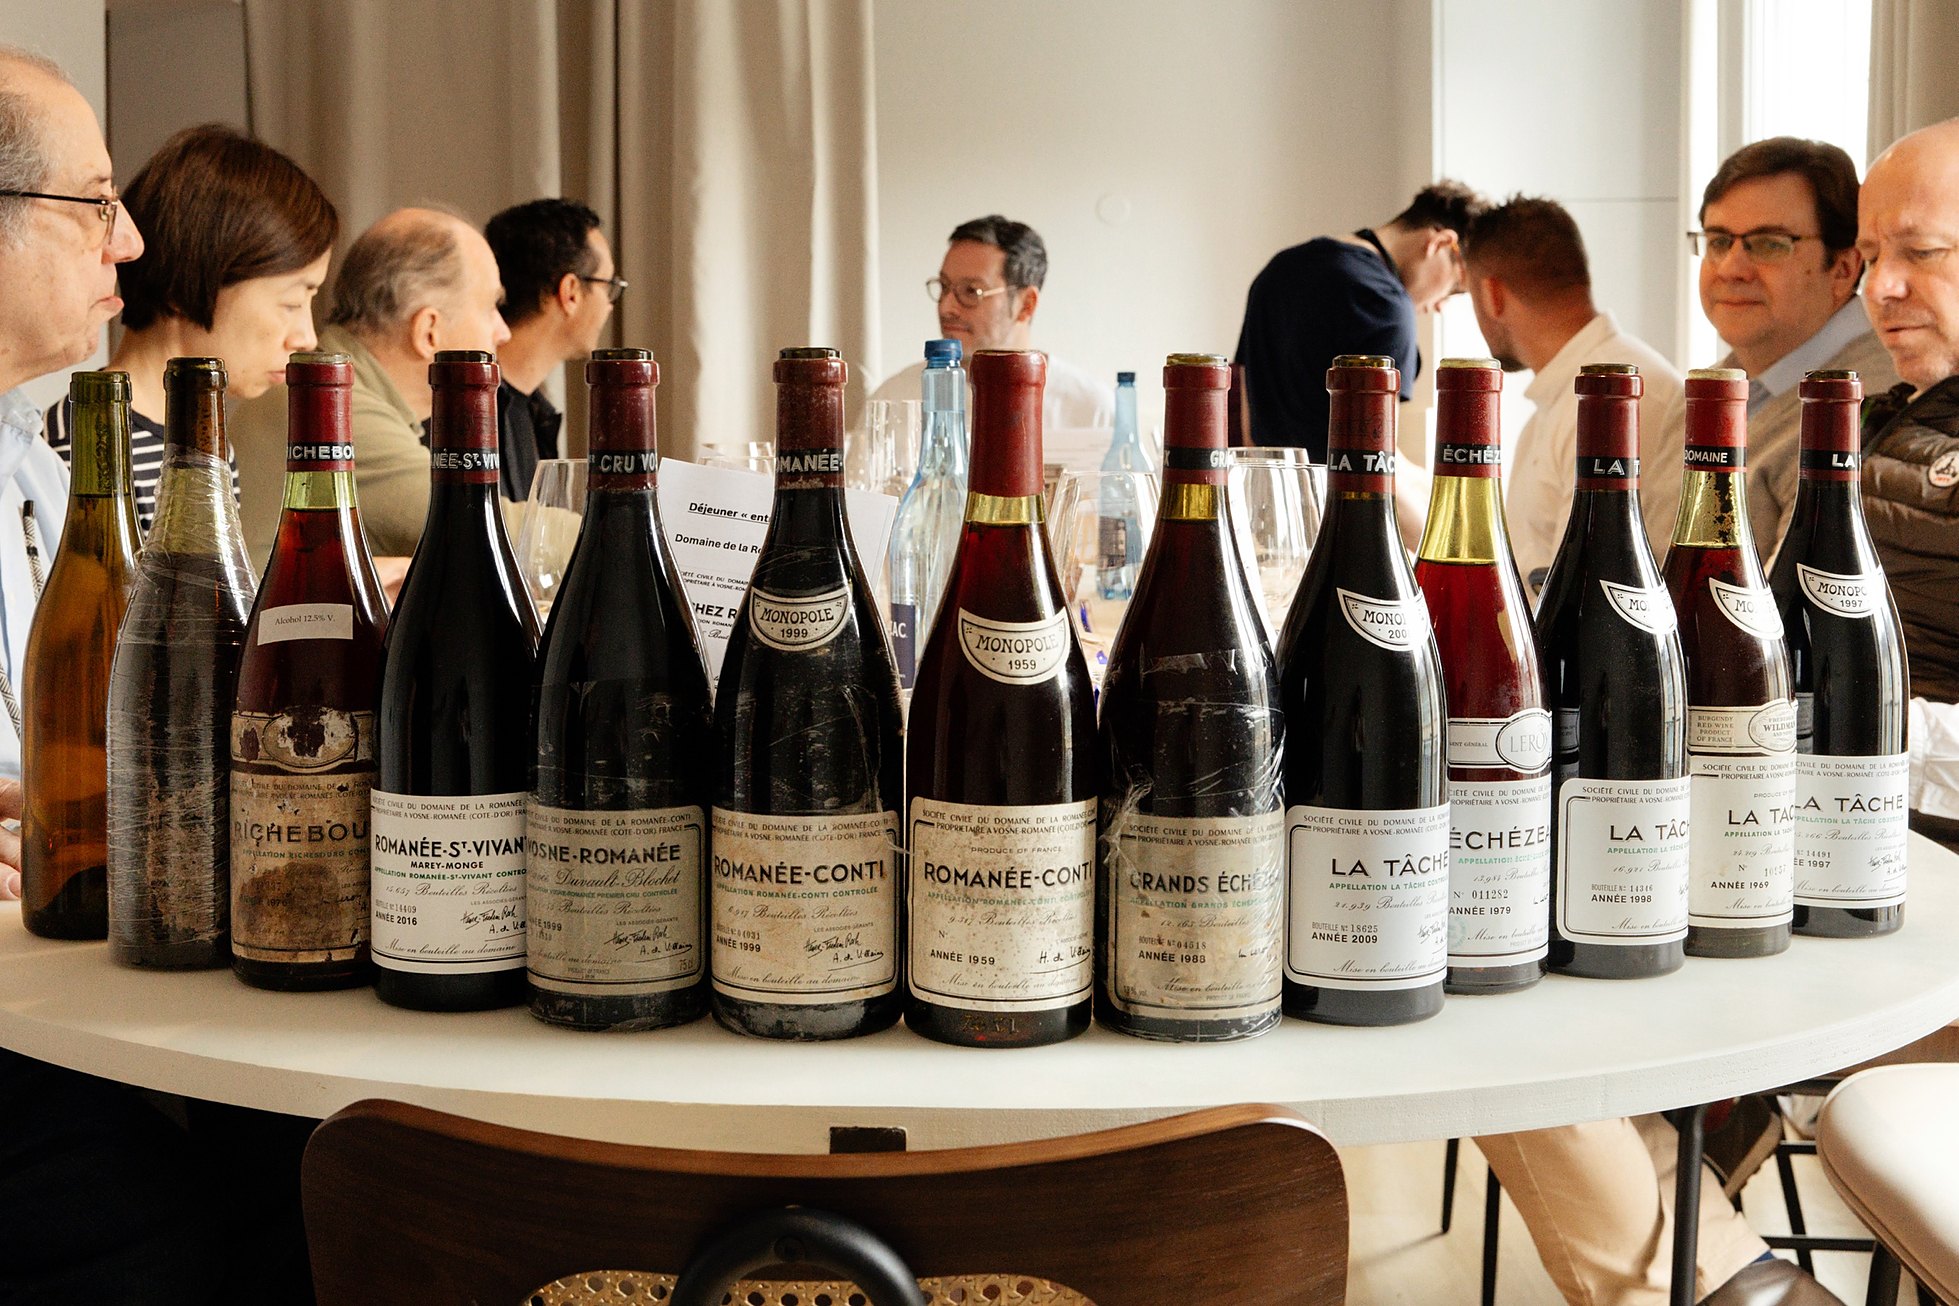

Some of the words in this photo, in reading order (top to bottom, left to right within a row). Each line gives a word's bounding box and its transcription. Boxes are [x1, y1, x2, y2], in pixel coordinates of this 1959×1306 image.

[1330, 454, 1352, 471] LA
[1684, 450, 1728, 463] DOMAINE
[1832, 454, 1856, 467] LA
[601, 455, 635, 473] CRU
[1593, 459, 1625, 475] LA
[689, 502, 738, 517] Déjeuner
[675, 534, 721, 548] Domaine
[723, 541, 736, 550] de
[739, 544, 748, 552] la
[275, 615, 301, 625] Alcohol
[303, 614, 325, 622] 12.5%
[760, 608, 834, 624] MONOPOLE
[781, 629, 808, 638] 1999
[976, 634, 1059, 653] MONOPOLE
[1008, 659, 1037, 670] 1959
[388, 801, 404, 809] CIVILE
[1834, 793, 1902, 812] TÂCHE
[409, 812, 466, 820] VOSNE-ROMANÉE
[564, 817, 596, 826] DOMAINE
[602, 818, 611, 826] DE
[631, 813, 691, 825] ROMANÉE-CONTI
[994, 817, 1031, 825] DOMAINE
[1303, 815, 1334, 824] SOCIÉTÉ
[1729, 810, 1760, 825] LA
[553, 826, 607, 836] VOSNE-ROMANÉE
[659, 824, 684, 834] FRANCE
[762, 823, 798, 832] DOMAINE
[803, 824, 813, 832] DE
[1313, 826, 1361, 835] PROPRIÉTAIRE
[1610, 825, 1643, 841] LA
[751, 833, 809, 842] VOSNE-ROMANÉE
[411, 861, 483, 869] MAREY-MONGE
[714, 855, 884, 885] ROMANÉE-CONTI
[1332, 858, 1370, 876] LA
[1384, 851, 1448, 877] TÂCHE
[1808, 860, 1831, 868] 1997
[555, 865, 681, 888] Duvault-Blochet
[924, 860, 1092, 889] ROMANÉE-CONTI
[1130, 871, 1209, 893] GRANDS
[1329, 882, 1387, 890] APPELLATION
[1711, 881, 1745, 889] ANNÉE
[1750, 881, 1769, 889] 1969
[415, 883, 468, 896] Bouteilles
[756, 890, 829, 899] ROMANÉE-CONTI
[1591, 894, 1627, 903] ANNÉE
[1630, 895, 1652, 903] 1998
[753, 904, 807, 920] Bouteilles
[1449, 906, 1485, 915] ANNÉE
[376, 911, 394, 923] ANNÉE
[397, 915, 418, 925] 2016
[1612, 918, 1637, 929] Mise
[543, 921, 562, 931] 1999
[1312, 922, 1338, 931] BOUTEILLE
[1350, 925, 1378, 933] 18625
[716, 935, 737, 949] ANNÉE
[739, 942, 761, 953] 1999
[1311, 932, 1348, 943] ANNÉE
[1352, 934, 1378, 943] 2009
[419, 944, 460, 954] bouteille
[477, 944, 516, 955] domaine
[930, 949, 963, 962] ANNÉE
[968, 955, 995, 965] 1959
[1138, 950, 1175, 963] ANNÉE
[1334, 960, 1362, 973] Mise
[1380, 960, 1416, 973] bouteille
[763, 972, 803, 984] bouteille
